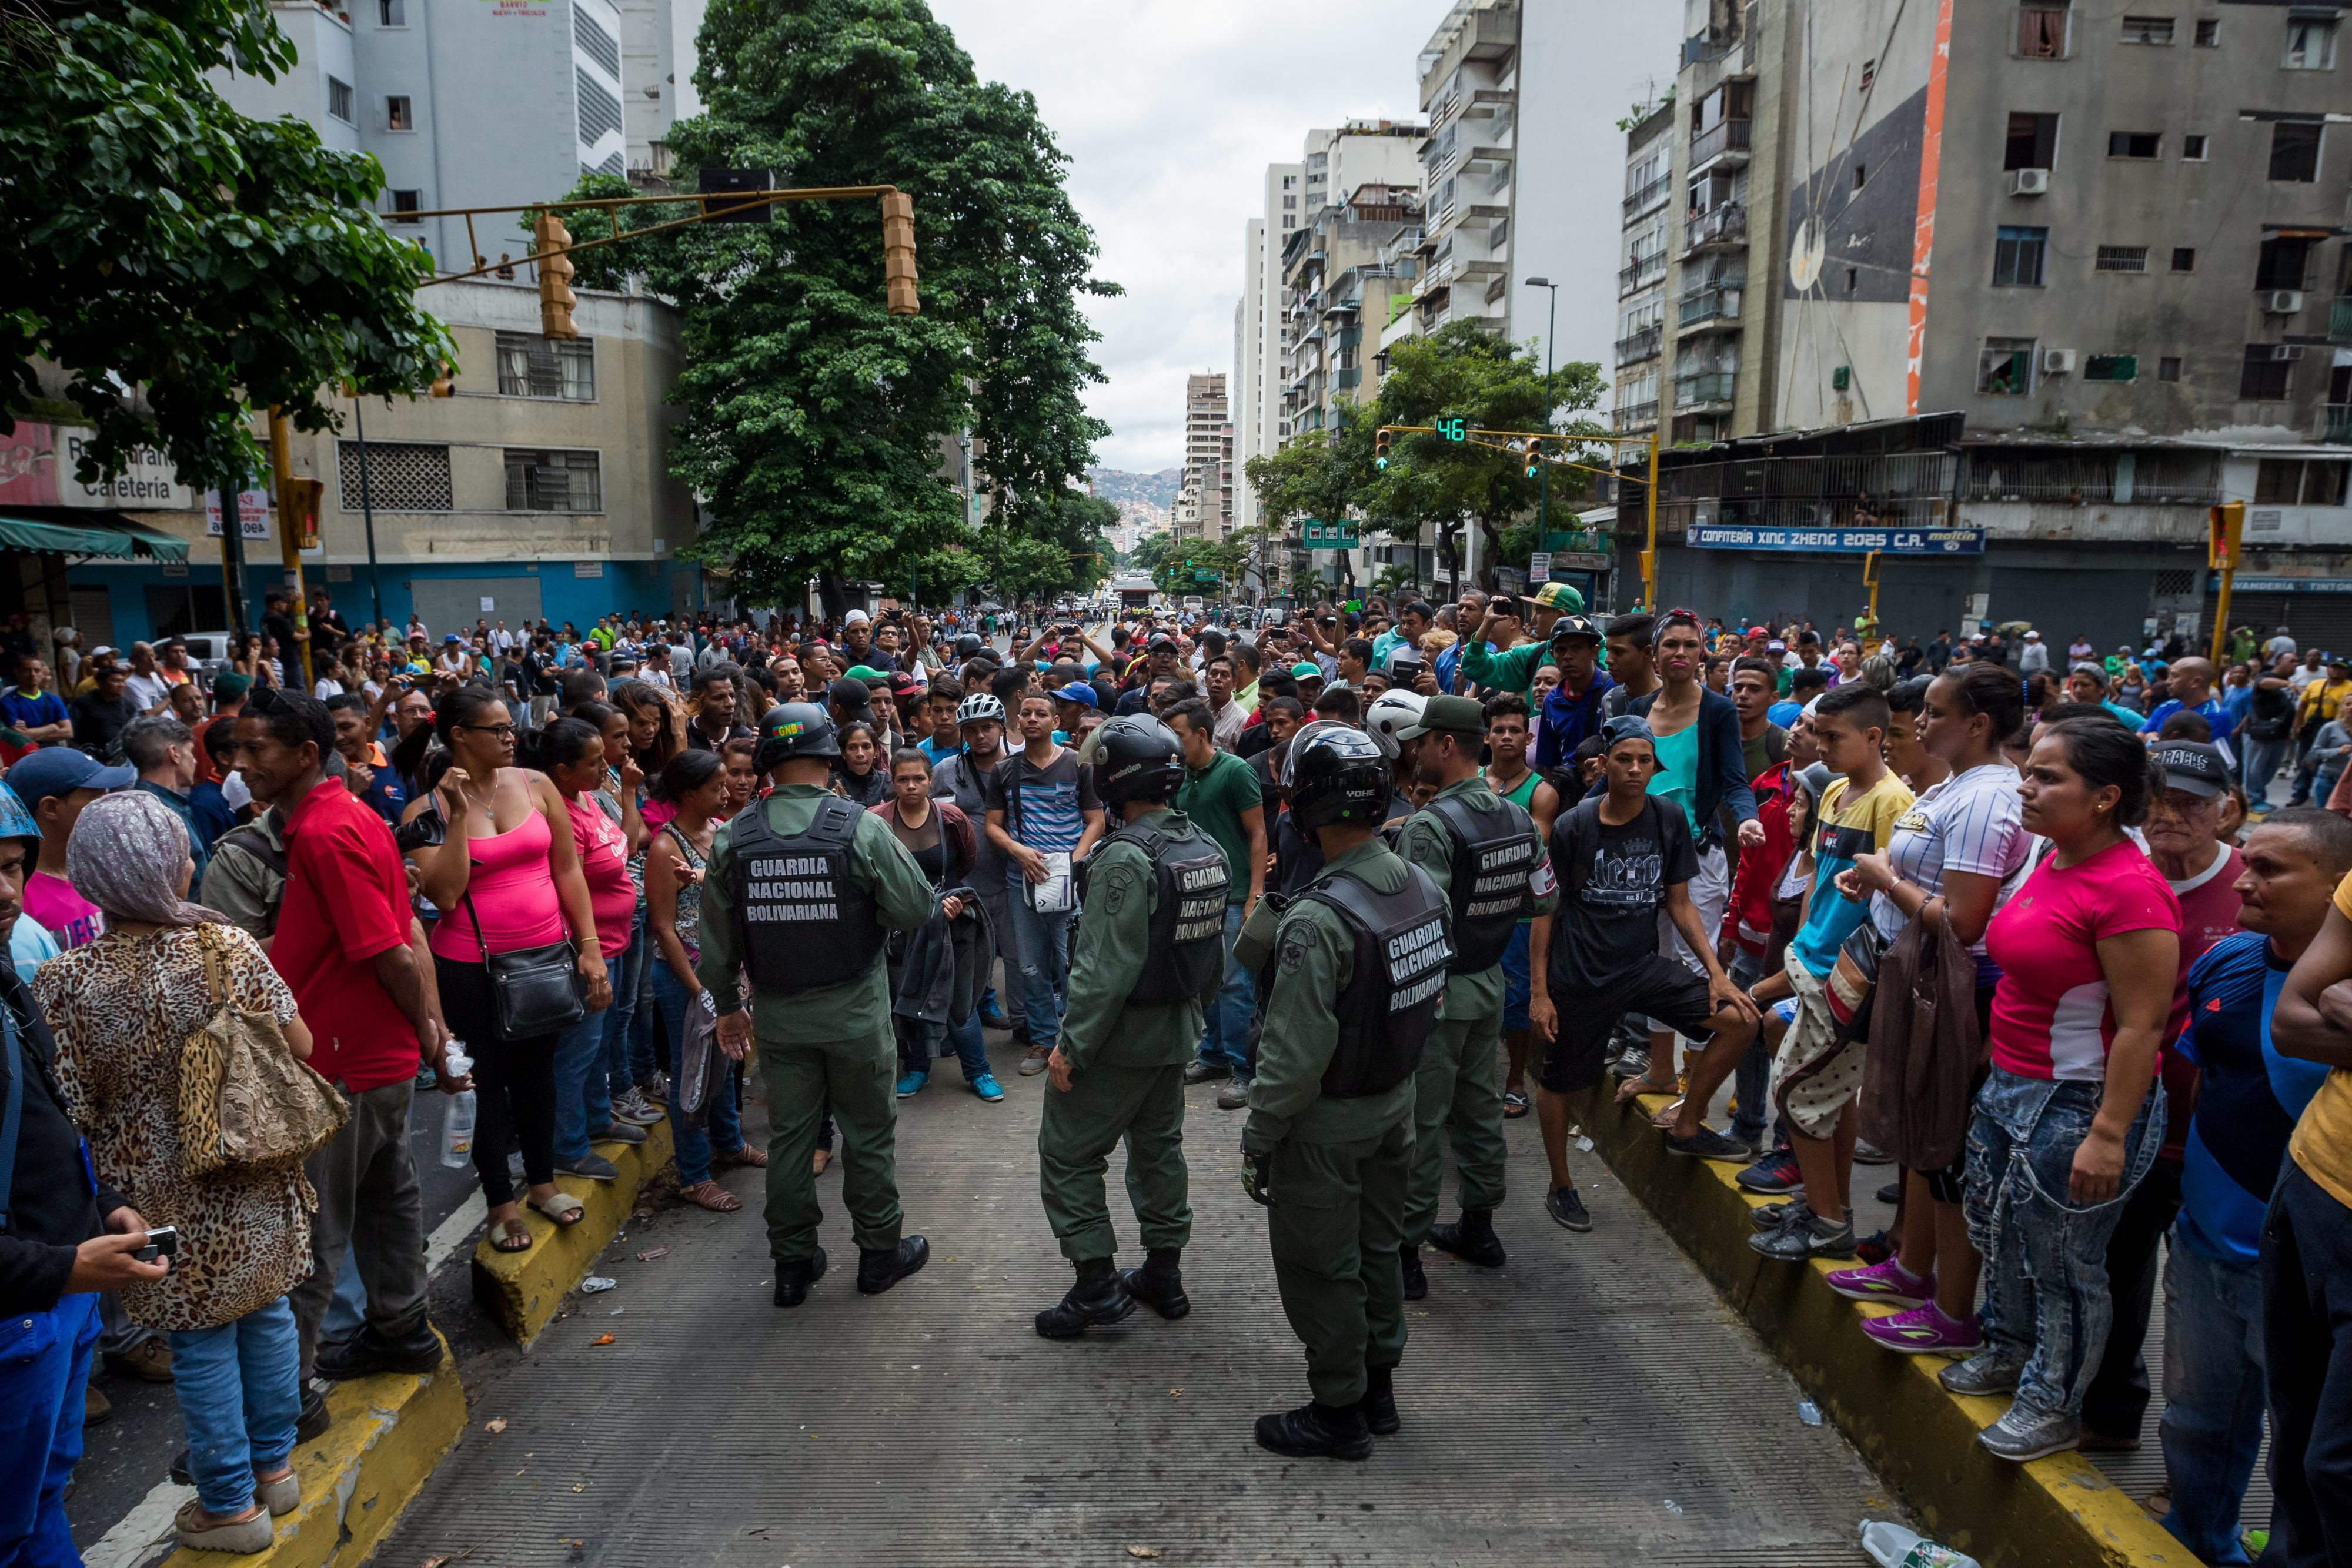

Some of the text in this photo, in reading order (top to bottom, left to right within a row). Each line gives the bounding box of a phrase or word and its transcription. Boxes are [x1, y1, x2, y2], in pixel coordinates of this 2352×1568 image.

[1438, 419, 1464, 441] 46
[1701, 529, 1925, 546] CONFITERÍA XING ZHENG 2025 C.A.
[779, 724, 797, 737] GNB
[1346, 789, 1375, 797] YOHE
[750, 857, 828, 877] GUARDIA
[1482, 842, 1532, 870] GUARDIA
[1183, 865, 1226, 890] GUARDIA
[1475, 870, 1527, 892] NACIONAL
[748, 882, 836, 898] NACIONAL
[747, 904, 838, 921] BOLIVARIANA
[1389, 918, 1444, 959] GUARDIA
[1391, 938, 1452, 982] NACIONAL
[1391, 969, 1445, 1011] BOLIVARIANA
